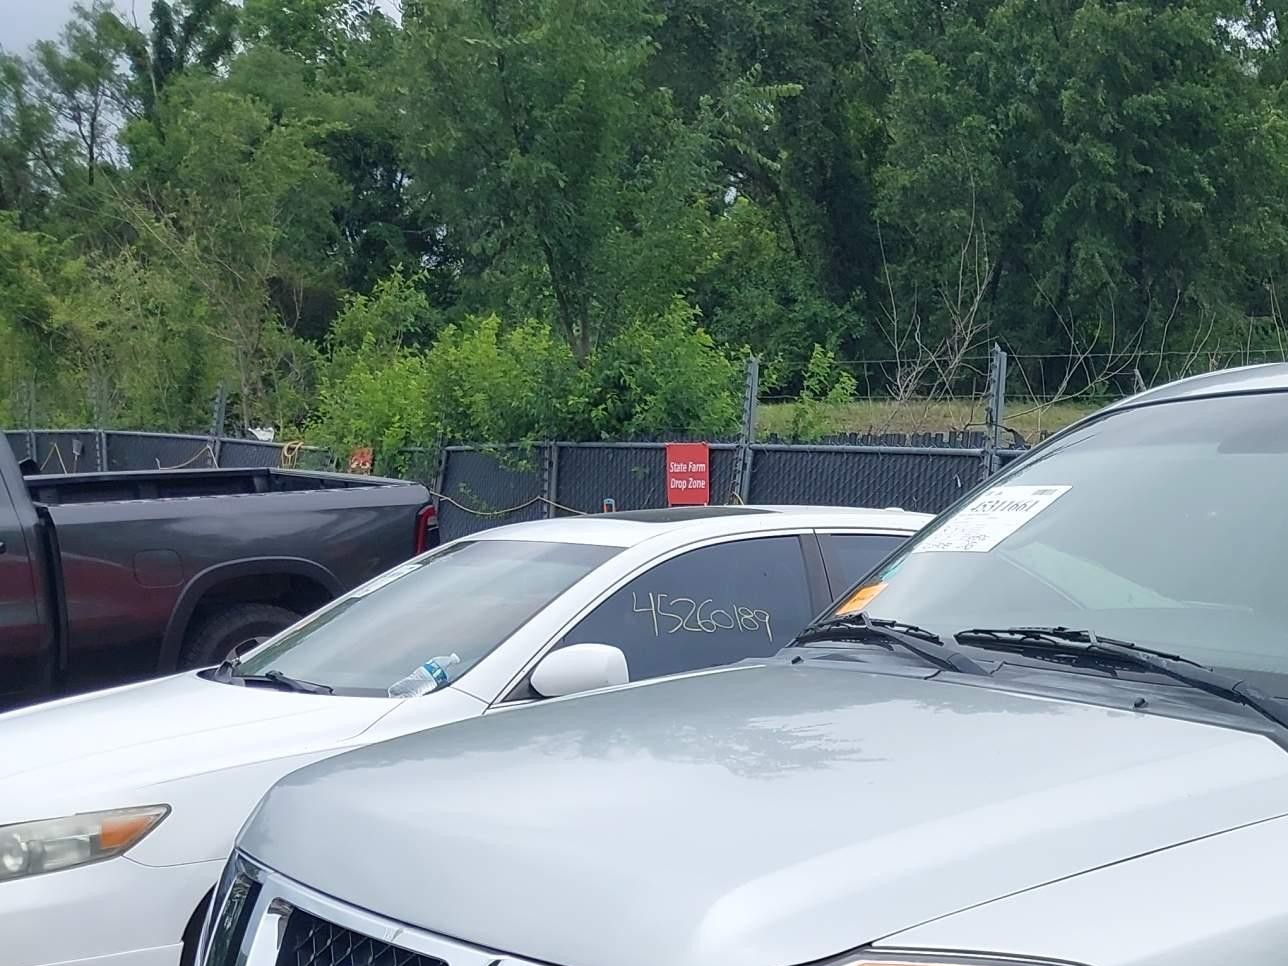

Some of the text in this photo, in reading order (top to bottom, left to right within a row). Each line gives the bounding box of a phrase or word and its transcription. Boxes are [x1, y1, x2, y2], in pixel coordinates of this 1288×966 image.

[670, 461, 706, 473] State Farm
[670, 477, 706, 491] Drop Zone
[632, 591, 773, 643] 45260189
